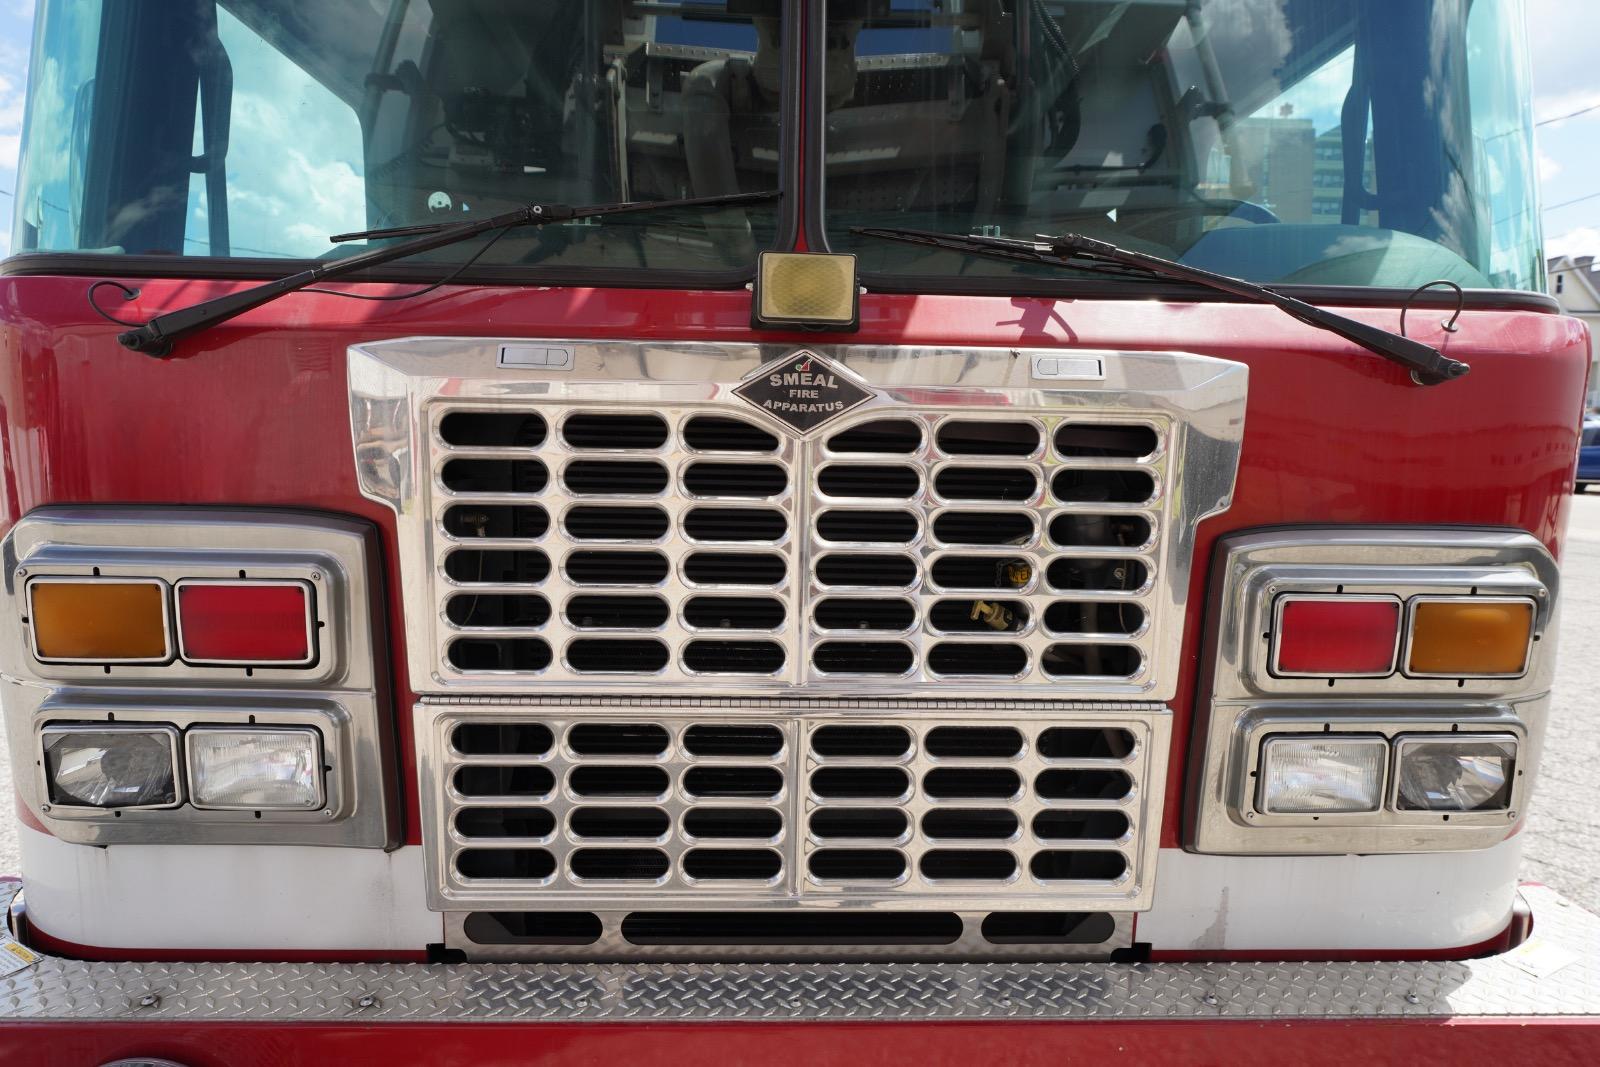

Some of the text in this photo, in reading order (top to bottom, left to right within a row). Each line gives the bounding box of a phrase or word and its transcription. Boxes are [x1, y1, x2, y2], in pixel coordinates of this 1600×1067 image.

[770, 372, 839, 389] SMEAL
[789, 389, 819, 399] FIRE
[763, 399, 845, 413] APPARATUS
